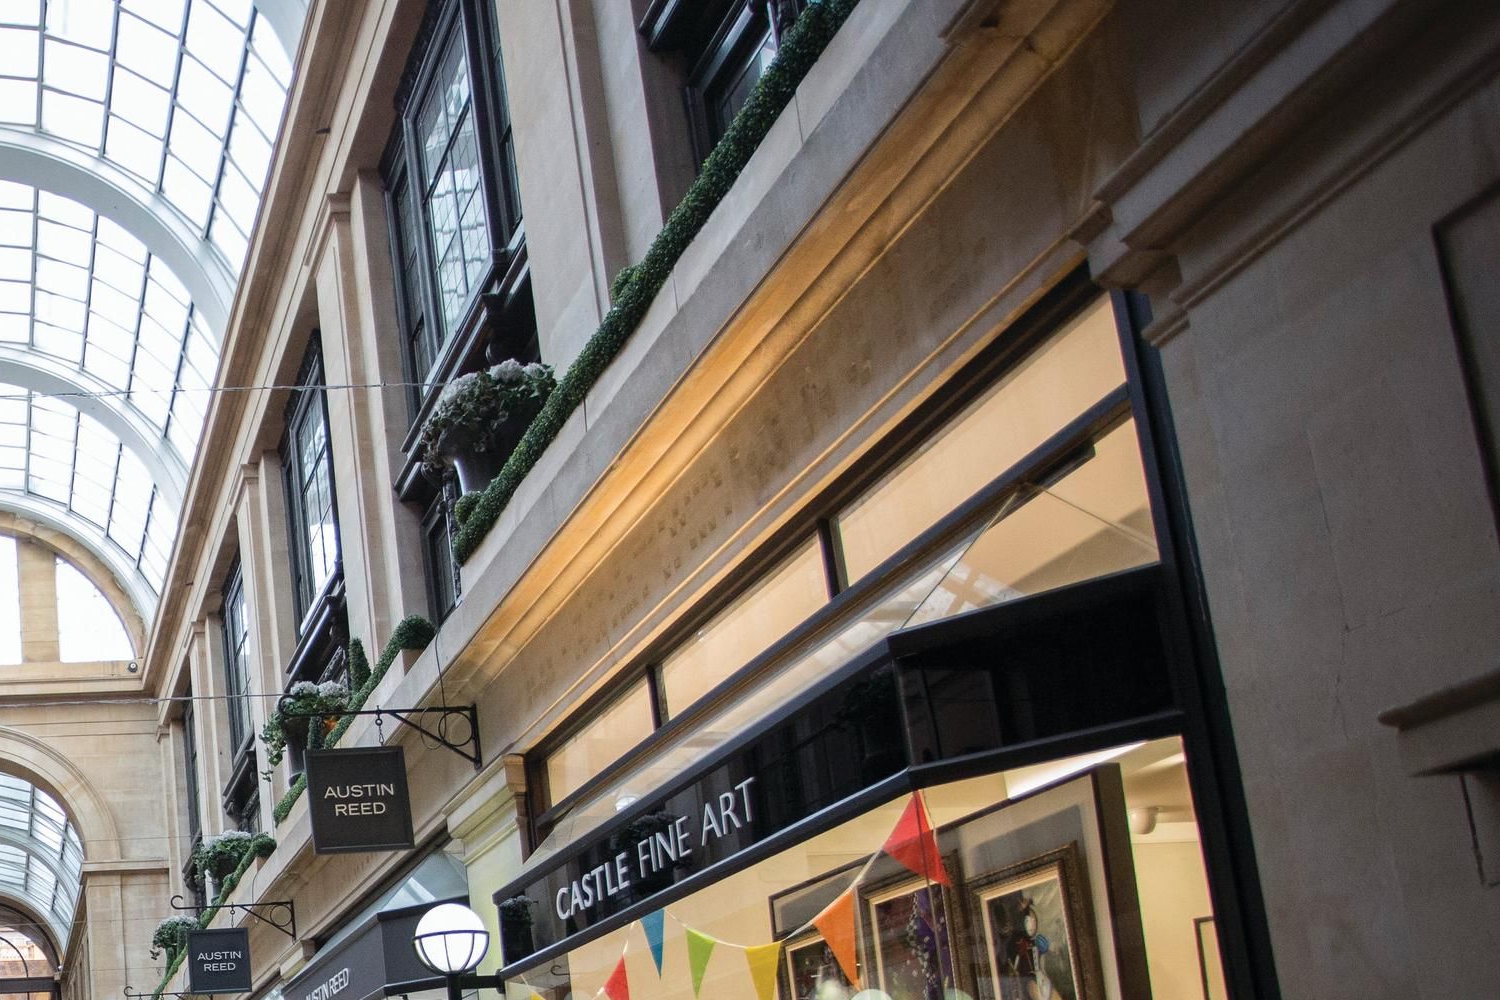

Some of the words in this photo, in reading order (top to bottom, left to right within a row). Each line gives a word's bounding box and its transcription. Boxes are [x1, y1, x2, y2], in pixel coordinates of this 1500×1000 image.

[324, 783, 395, 799] AUSTIN
[334, 802, 386, 816] REED
[556, 851, 631, 921] CASTLE
[637, 815, 693, 879] FINE
[701, 776, 755, 847] ART
[197, 950, 242, 961] AUSTIN
[203, 962, 236, 972] REED
[328, 967, 349, 998] REED
